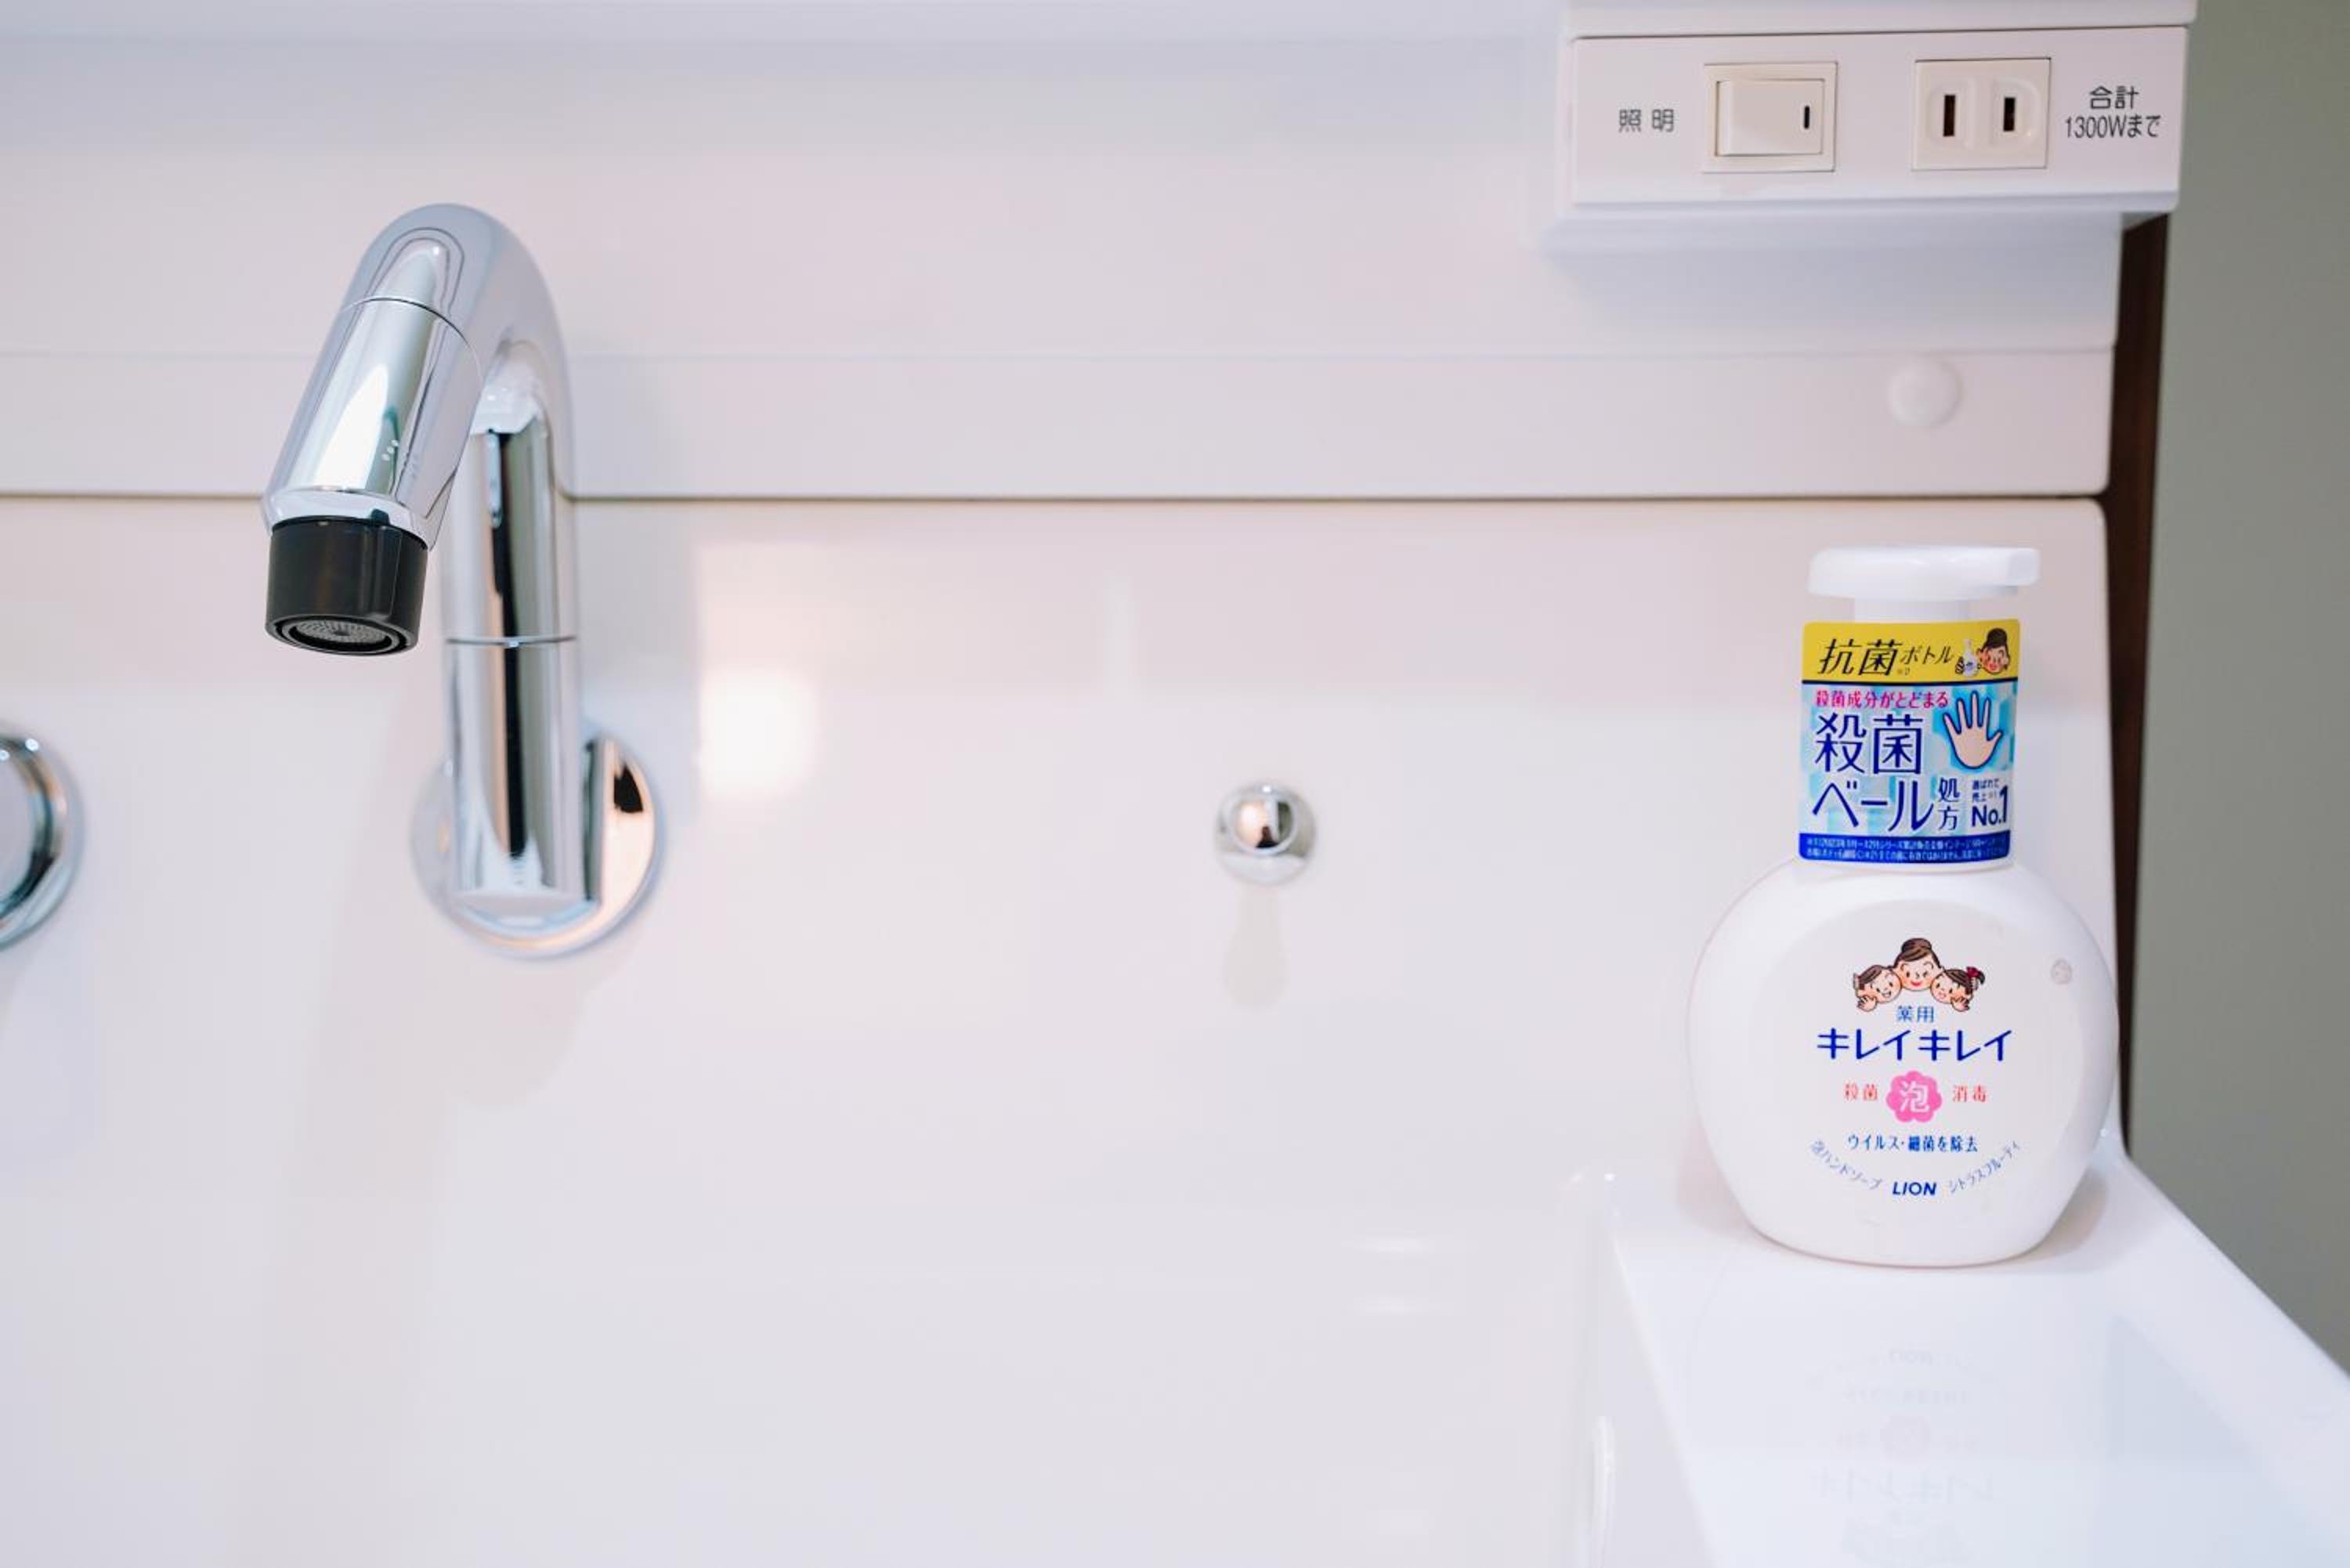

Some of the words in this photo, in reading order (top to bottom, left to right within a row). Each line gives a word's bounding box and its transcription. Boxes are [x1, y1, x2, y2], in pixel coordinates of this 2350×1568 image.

[2089, 85, 2140, 110] 合計
[1618, 108, 1675, 133] 照明
[2065, 114, 2161, 139] 1300Wまで
[1816, 689, 1949, 709] 殺菌成分がとどまる
[1814, 712, 1924, 775] 殺菌
[1812, 780, 1934, 832] ベール
[1972, 785, 2008, 827] No.1
[1896, 1005, 1934, 1023] 薬用
[1817, 1028, 2012, 1061] キレイキレイ
[1844, 1082, 1878, 1101] 殺菌
[1899, 1080, 1930, 1113] 泡
[1952, 1084, 1987, 1103] 消毒
[1848, 1134, 1979, 1152] ウイルス・細菌を除去
[1949, 1140, 2021, 1194] シトラスフルーティ
[1892, 1181, 1937, 1196] LION
